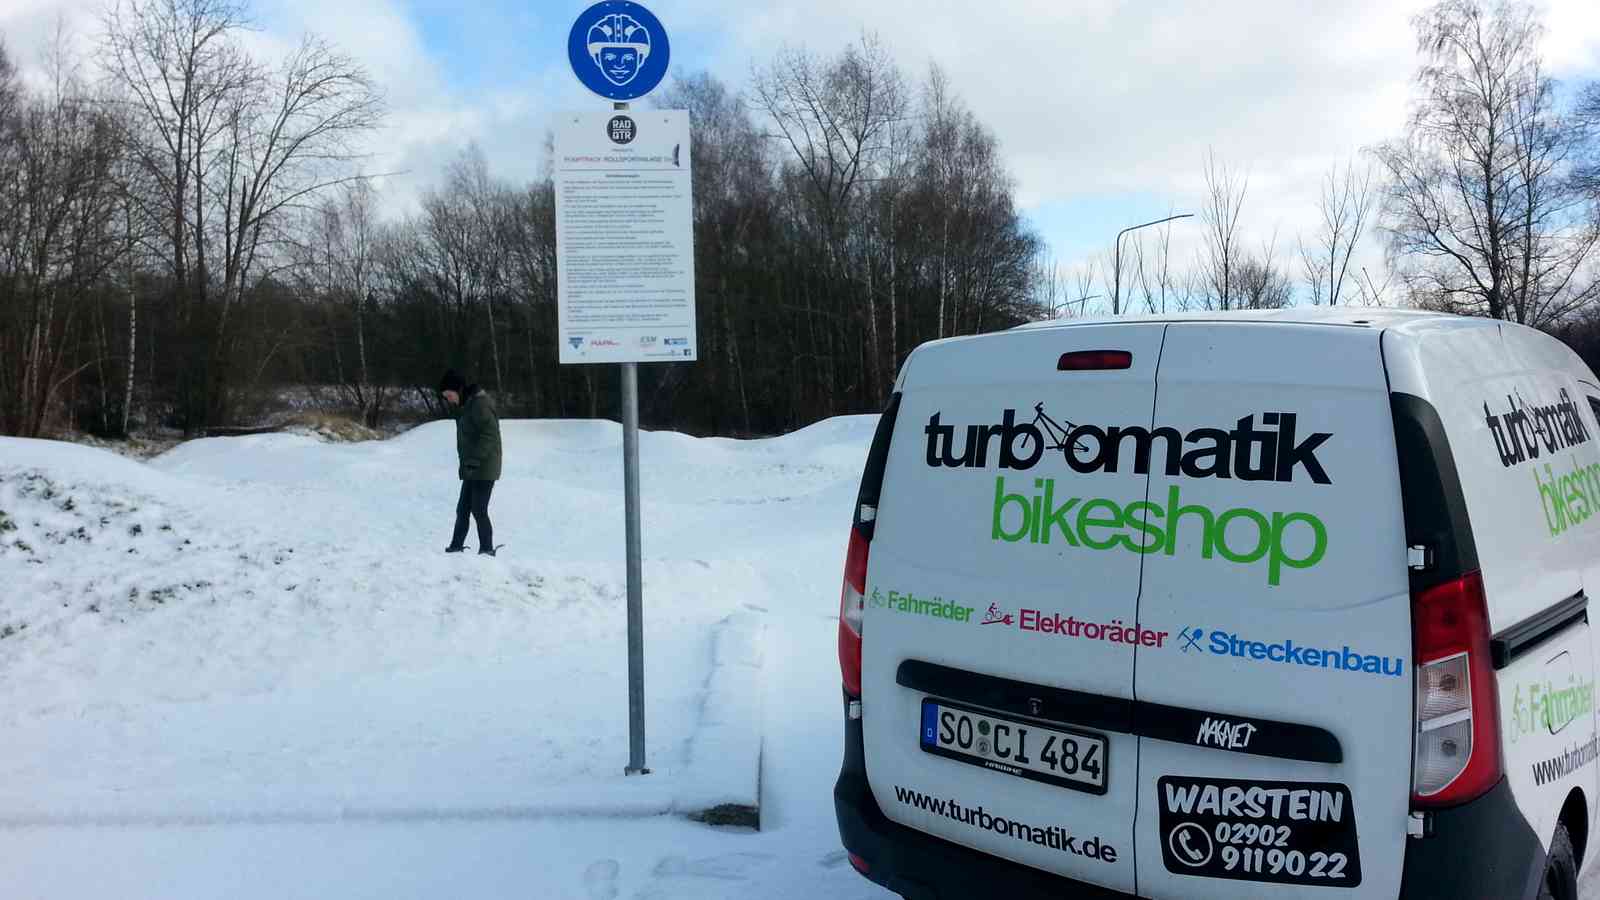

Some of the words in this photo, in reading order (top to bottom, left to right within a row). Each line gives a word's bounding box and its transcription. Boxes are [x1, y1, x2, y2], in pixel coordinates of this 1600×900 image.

[612, 119, 632, 129] RAD
[925, 405, 1332, 484] turbomatik
[992, 476, 1328, 586] bikeshop
[887, 590, 974, 624] Fahrräder
[1019, 609, 1168, 648] Elektroräder
[1209, 630, 1402, 676] Streckenbau
[939, 711, 974, 750] SO
[993, 724, 1030, 764] CI
[1040, 735, 1101, 779] 484
[1196, 717, 1257, 749] MAGNET
[895, 785, 1117, 863] www.turbomatik.de
[1165, 782, 1344, 822] WARSTEIN
[1215, 821, 1291, 847] 02902
[1221, 845, 1348, 879] 9119022
